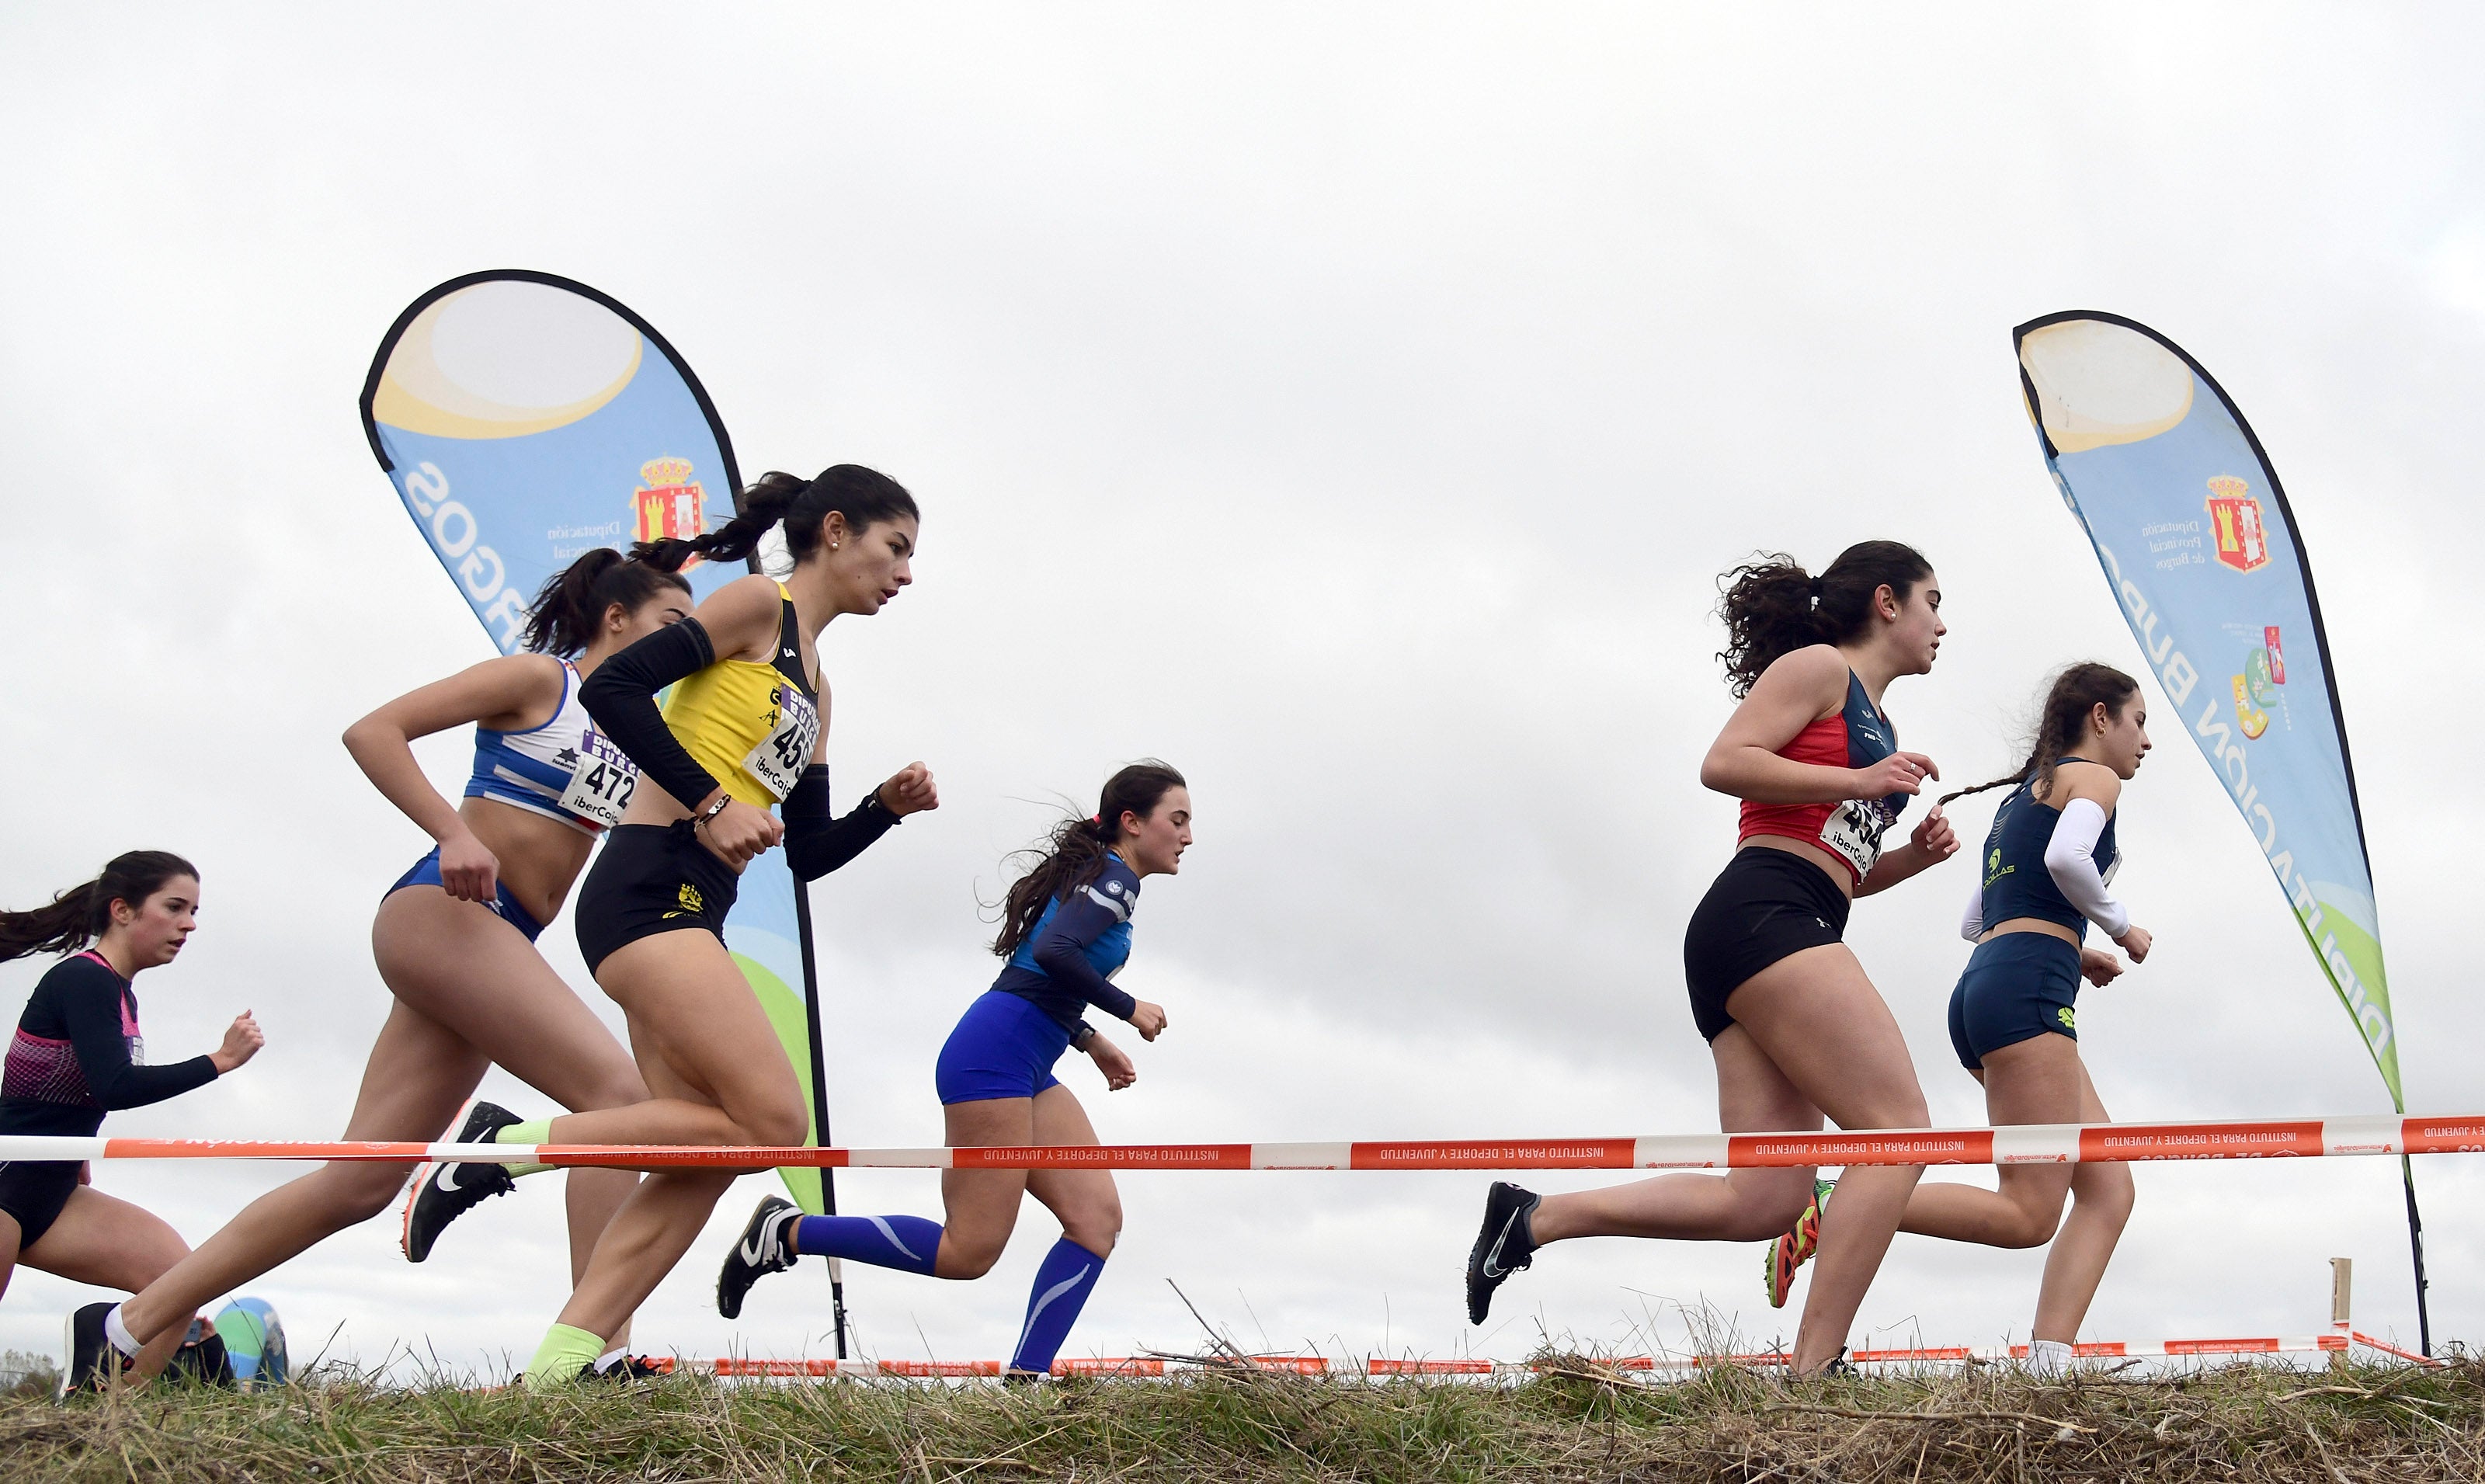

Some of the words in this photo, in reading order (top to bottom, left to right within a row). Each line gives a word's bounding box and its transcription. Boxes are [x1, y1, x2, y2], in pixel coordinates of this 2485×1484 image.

[585, 762, 635, 810] 472
[1833, 830, 1868, 871] iberCaja
[2250, 1131, 2297, 1142] INSTITUTO
[2424, 1126, 2469, 1138] JUVENTUD
[2104, 1136, 2153, 1147] JUVENTUD
[2156, 1136, 2163, 1145] Y
[2164, 1135, 2207, 1145] DEPORTE
[2209, 1134, 2220, 1144] EL
[2223, 1133, 2247, 1143] PARA
[1755, 1143, 1809, 1155] JUVENTUD
[1811, 1143, 1819, 1154] Y
[1820, 1142, 1867, 1154] DEPORTE
[1870, 1142, 1881, 1152] EL
[1885, 1142, 1910, 1152] PARA
[1913, 1141, 1965, 1152] INSTITUTO
[983, 1150, 1044, 1160] JUVENTUD
[1045, 1150, 1054, 1160] Y
[1056, 1150, 1108, 1160] DEPORTE
[1111, 1150, 1124, 1160] EL
[1128, 1150, 1157, 1160] PARA
[1161, 1150, 1219, 1160] INSTITUTO
[1380, 1149, 1437, 1159] JUVENTUD
[1439, 1149, 1448, 1159] Y
[1450, 1149, 1499, 1159] DEPORTE
[1502, 1149, 1514, 1159] EL
[1517, 1148, 1545, 1159] PARA
[1548, 1148, 1604, 1158] INSTITUTO
